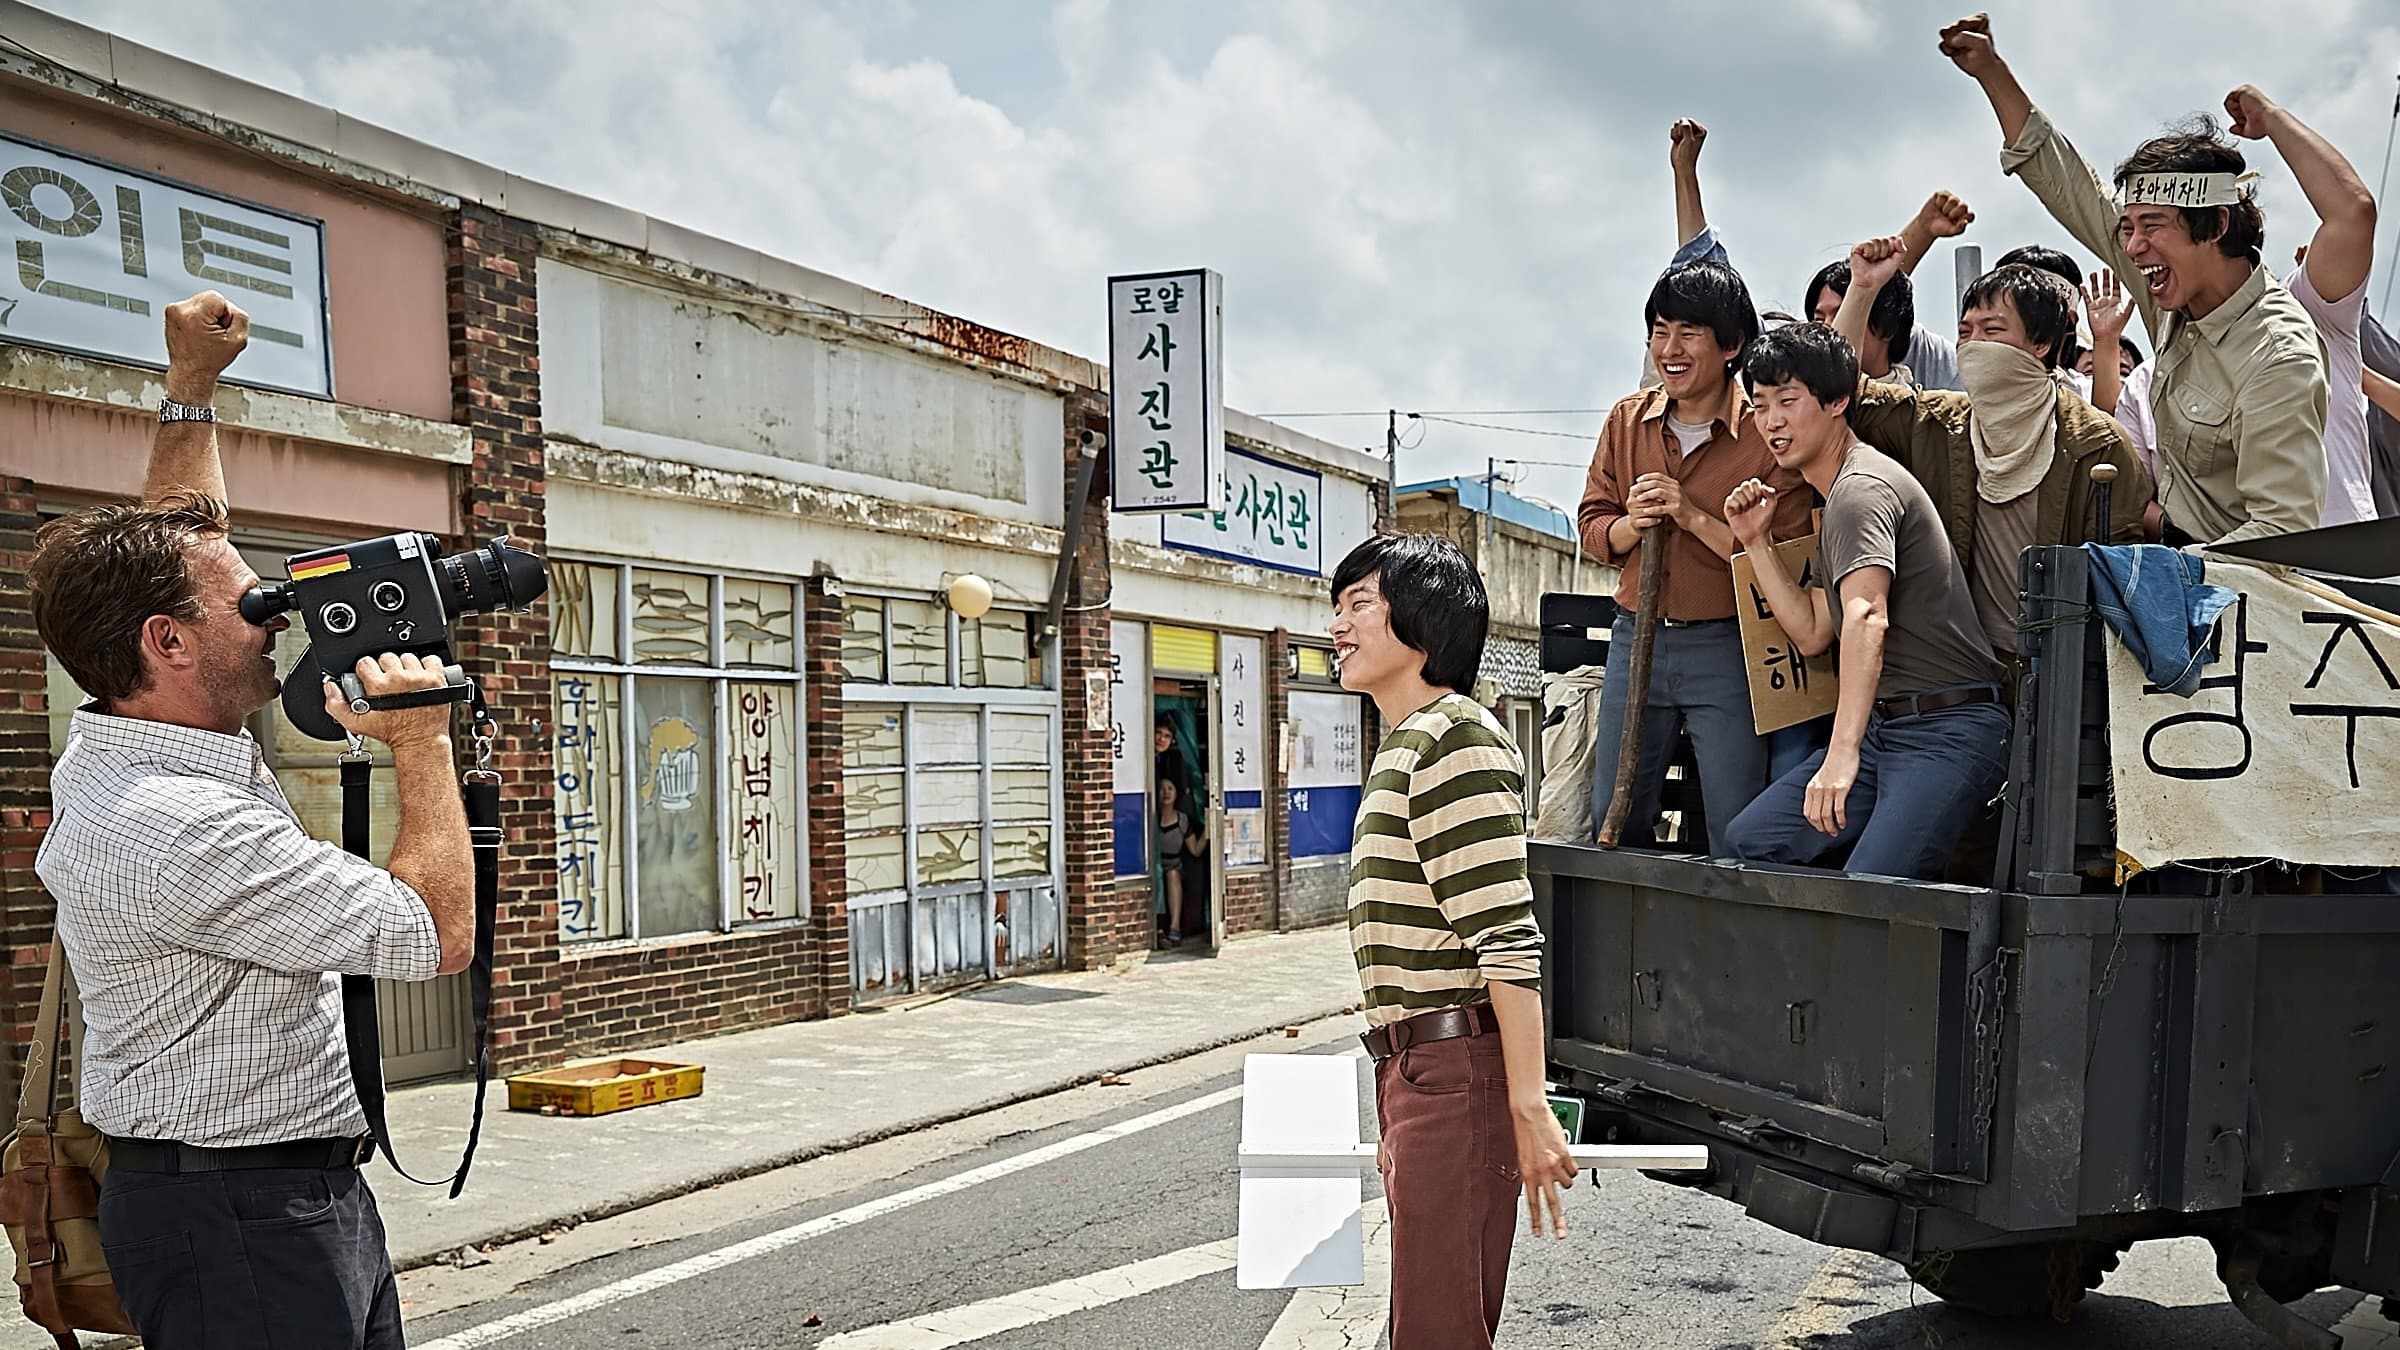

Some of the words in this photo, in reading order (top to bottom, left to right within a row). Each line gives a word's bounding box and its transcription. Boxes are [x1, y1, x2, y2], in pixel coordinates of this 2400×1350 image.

[1129, 281, 1184, 315] 로얄
[1136, 322, 1178, 489] 사진관
[1232, 654, 1245, 774] 사진관
[741, 692, 774, 919] 양념치킨
